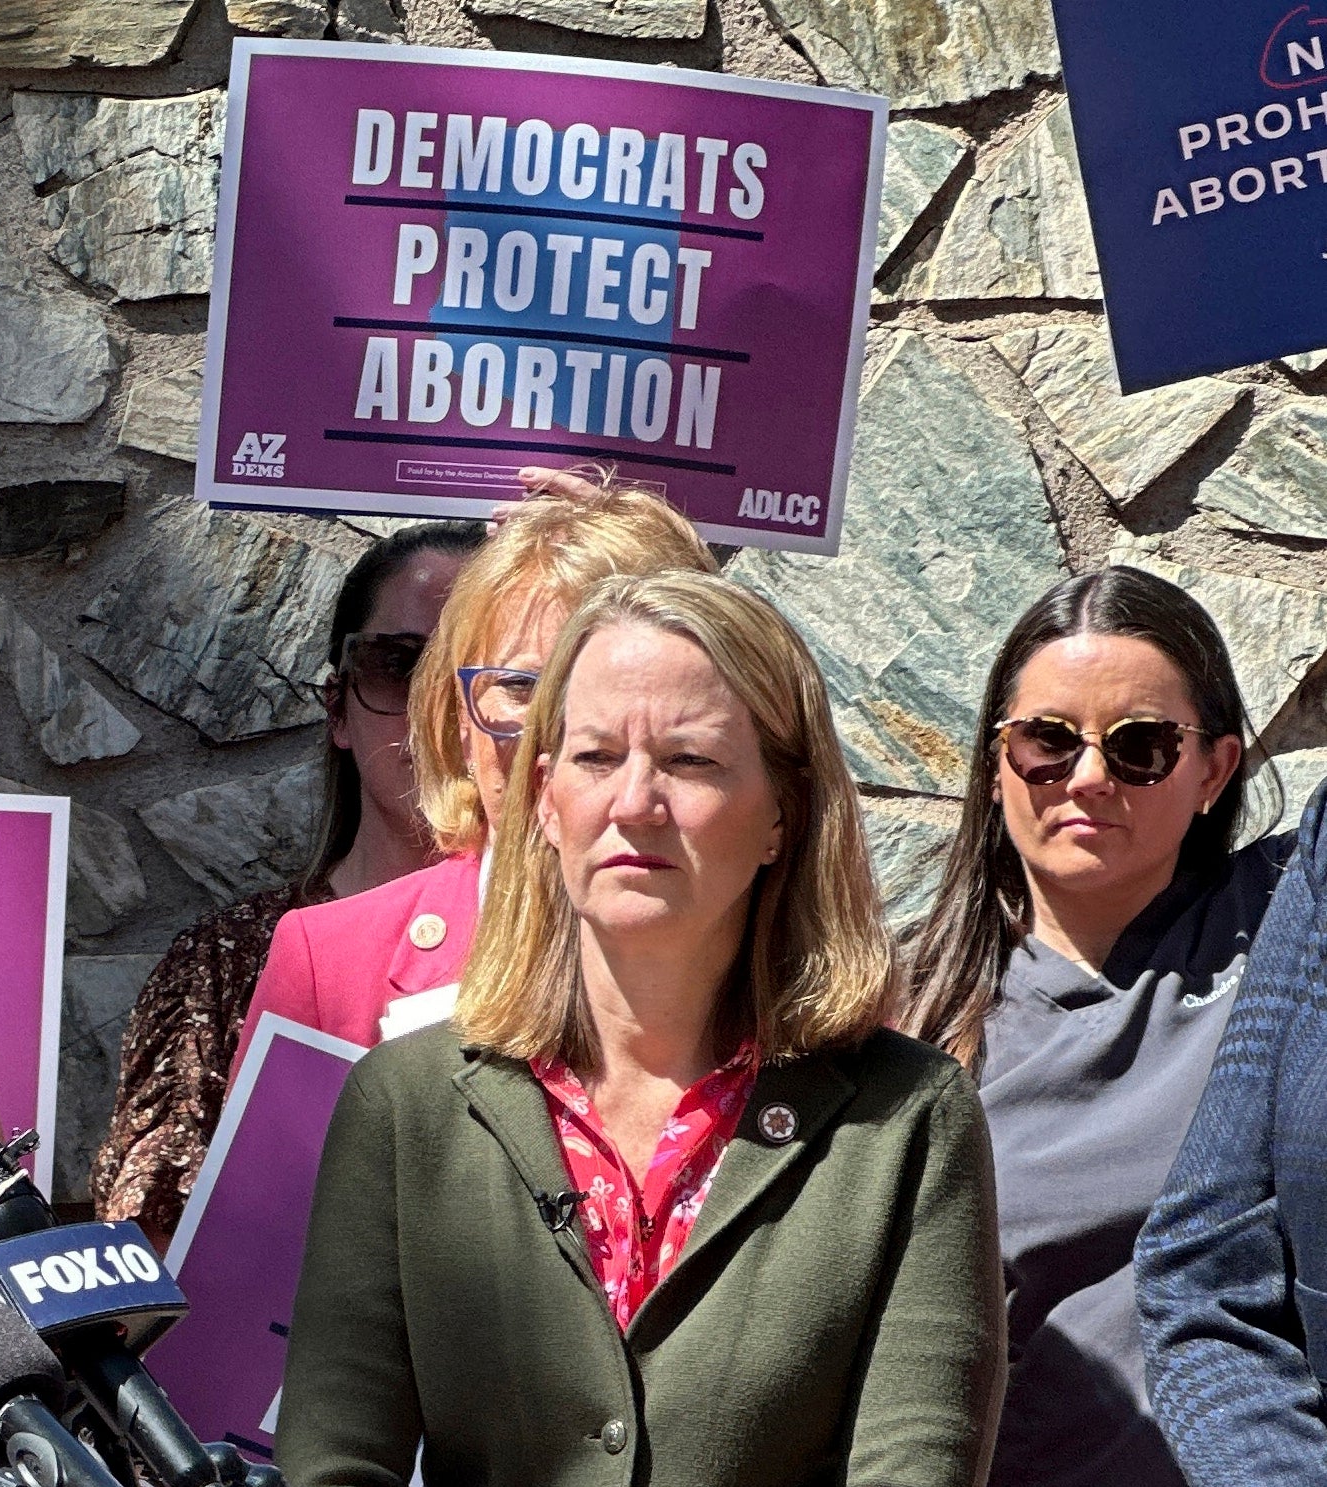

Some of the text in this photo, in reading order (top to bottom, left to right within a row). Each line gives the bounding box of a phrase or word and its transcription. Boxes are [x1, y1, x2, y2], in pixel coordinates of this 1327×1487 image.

[1179, 91, 1327, 160] PROH
[351, 108, 768, 220] DEMOCRATS
[392, 223, 713, 330] PROTECT
[354, 336, 722, 450] ABORTION
[231, 462, 285, 478] DEMS
[232, 432, 287, 465] AZ
[737, 487, 821, 526] ADLCC
